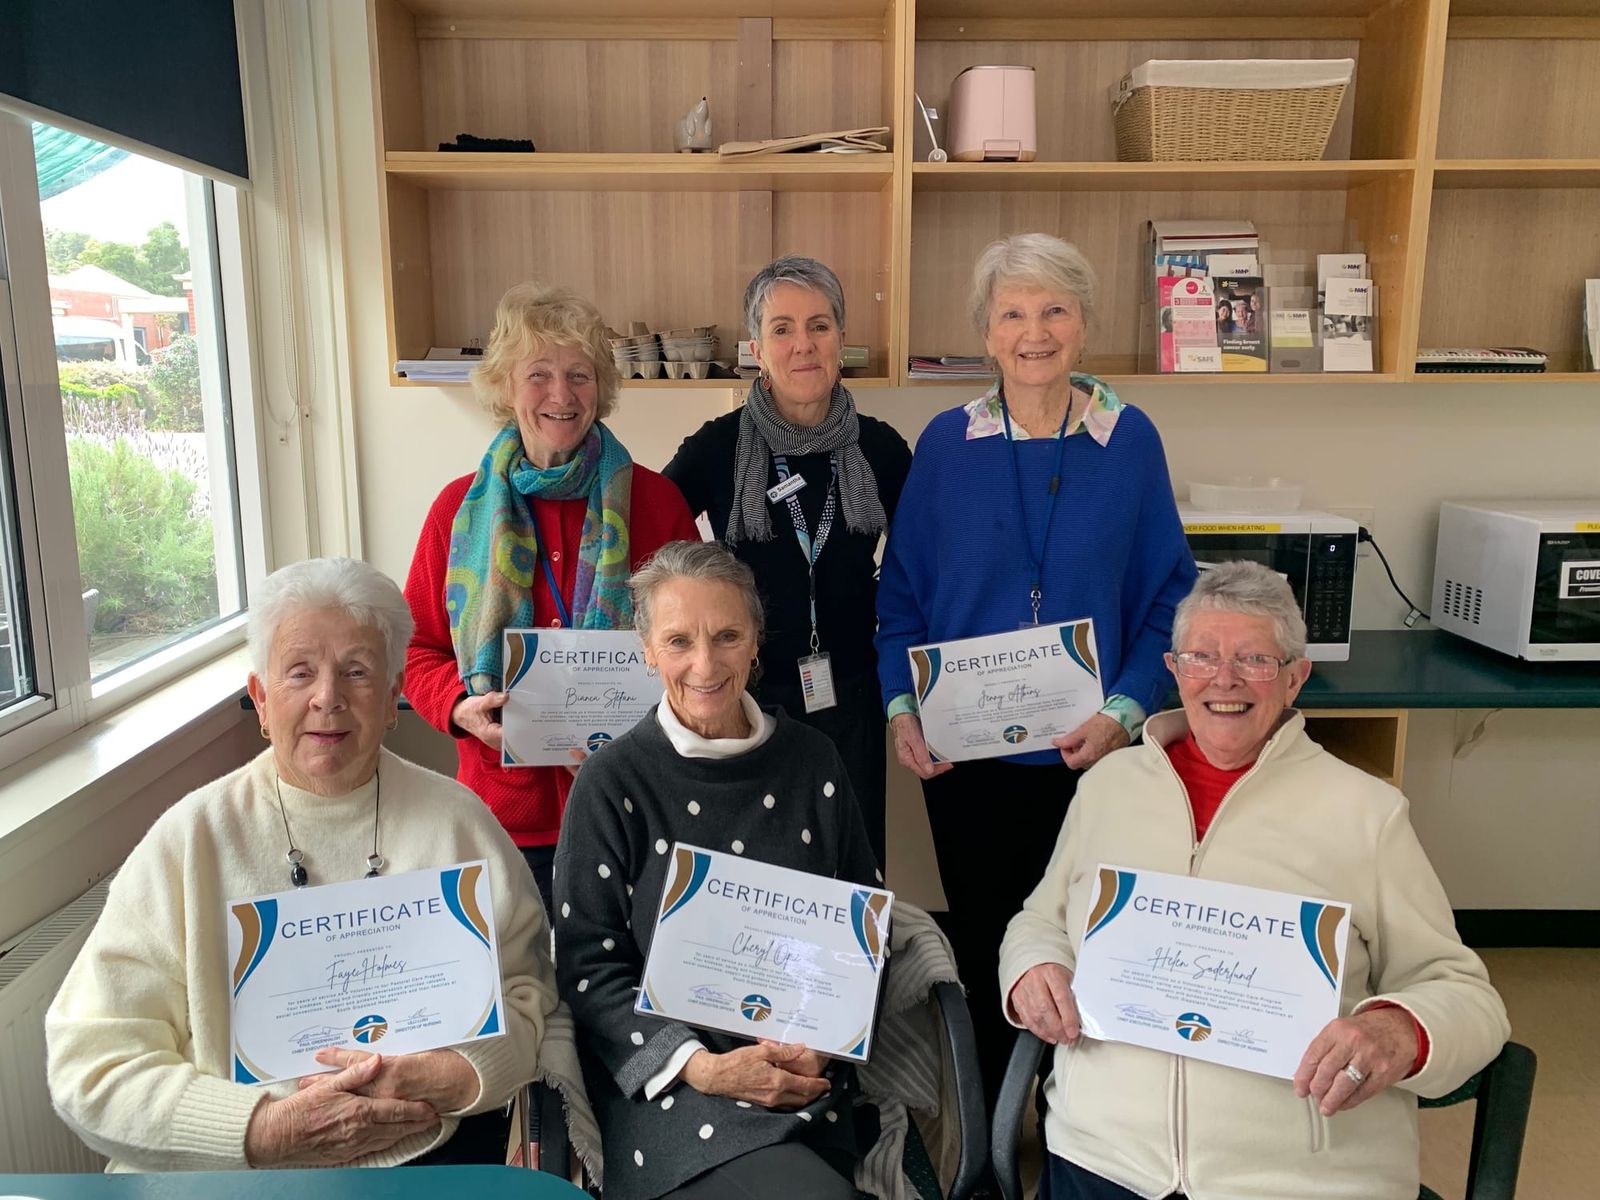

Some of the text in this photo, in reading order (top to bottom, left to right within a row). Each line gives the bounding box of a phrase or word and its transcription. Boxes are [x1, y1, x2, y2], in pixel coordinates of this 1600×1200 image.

[540, 651, 647, 664] CERTIFICAT
[943, 643, 1062, 673] CERTIFICATE
[987, 663, 1032, 674] APPRECIATION
[706, 877, 847, 924] CERTIFICATE
[281, 896, 441, 939] CERTIFICATE
[741, 905, 807, 926] OF APPRECIATION
[1132, 895, 1296, 938] CERTIFICATE
[325, 923, 400, 942] OF APPRECIATION
[1185, 923, 1248, 940] APPRECIATION
[731, 932, 774, 967] Cheryl
[1147, 946, 1188, 971] Helen
